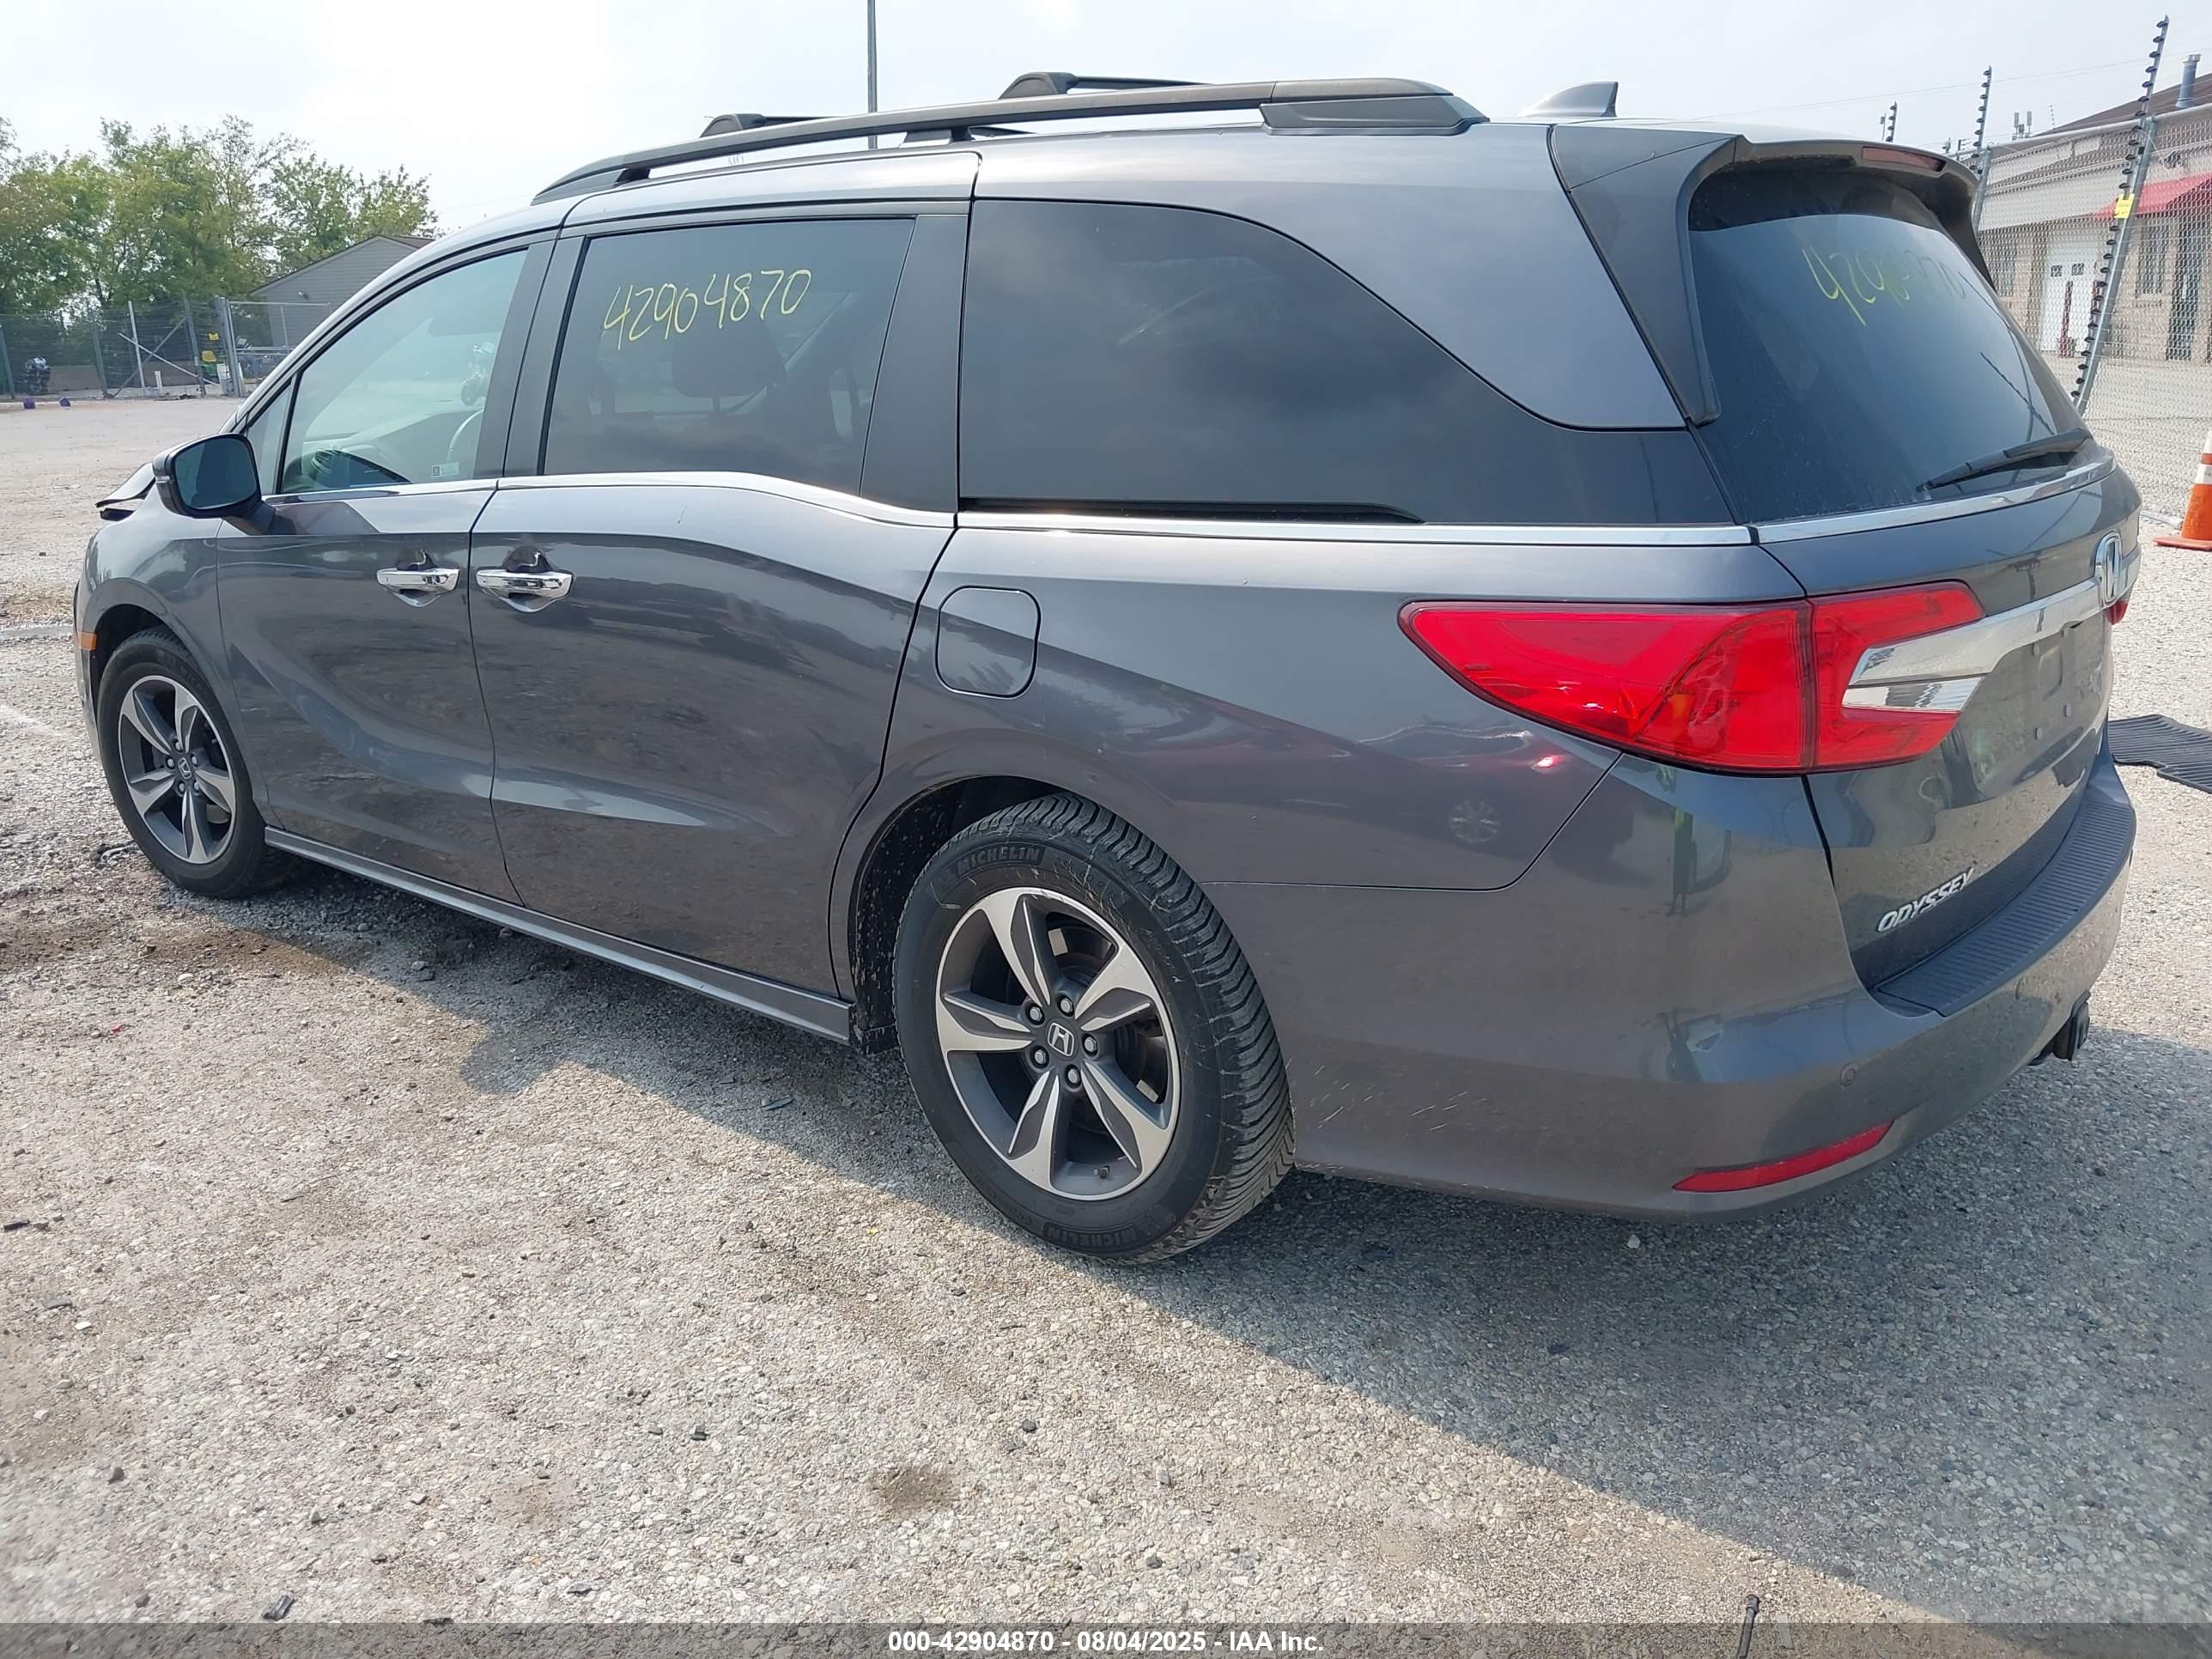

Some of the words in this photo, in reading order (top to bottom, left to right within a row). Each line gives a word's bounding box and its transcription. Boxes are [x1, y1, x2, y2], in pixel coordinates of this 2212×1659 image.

[603, 269, 812, 351] 42904870
[956, 845, 1042, 875] MICHELIN
[1877, 866, 1974, 932] ODYSSEY
[1046, 1225, 1139, 1246] MICHELIN
